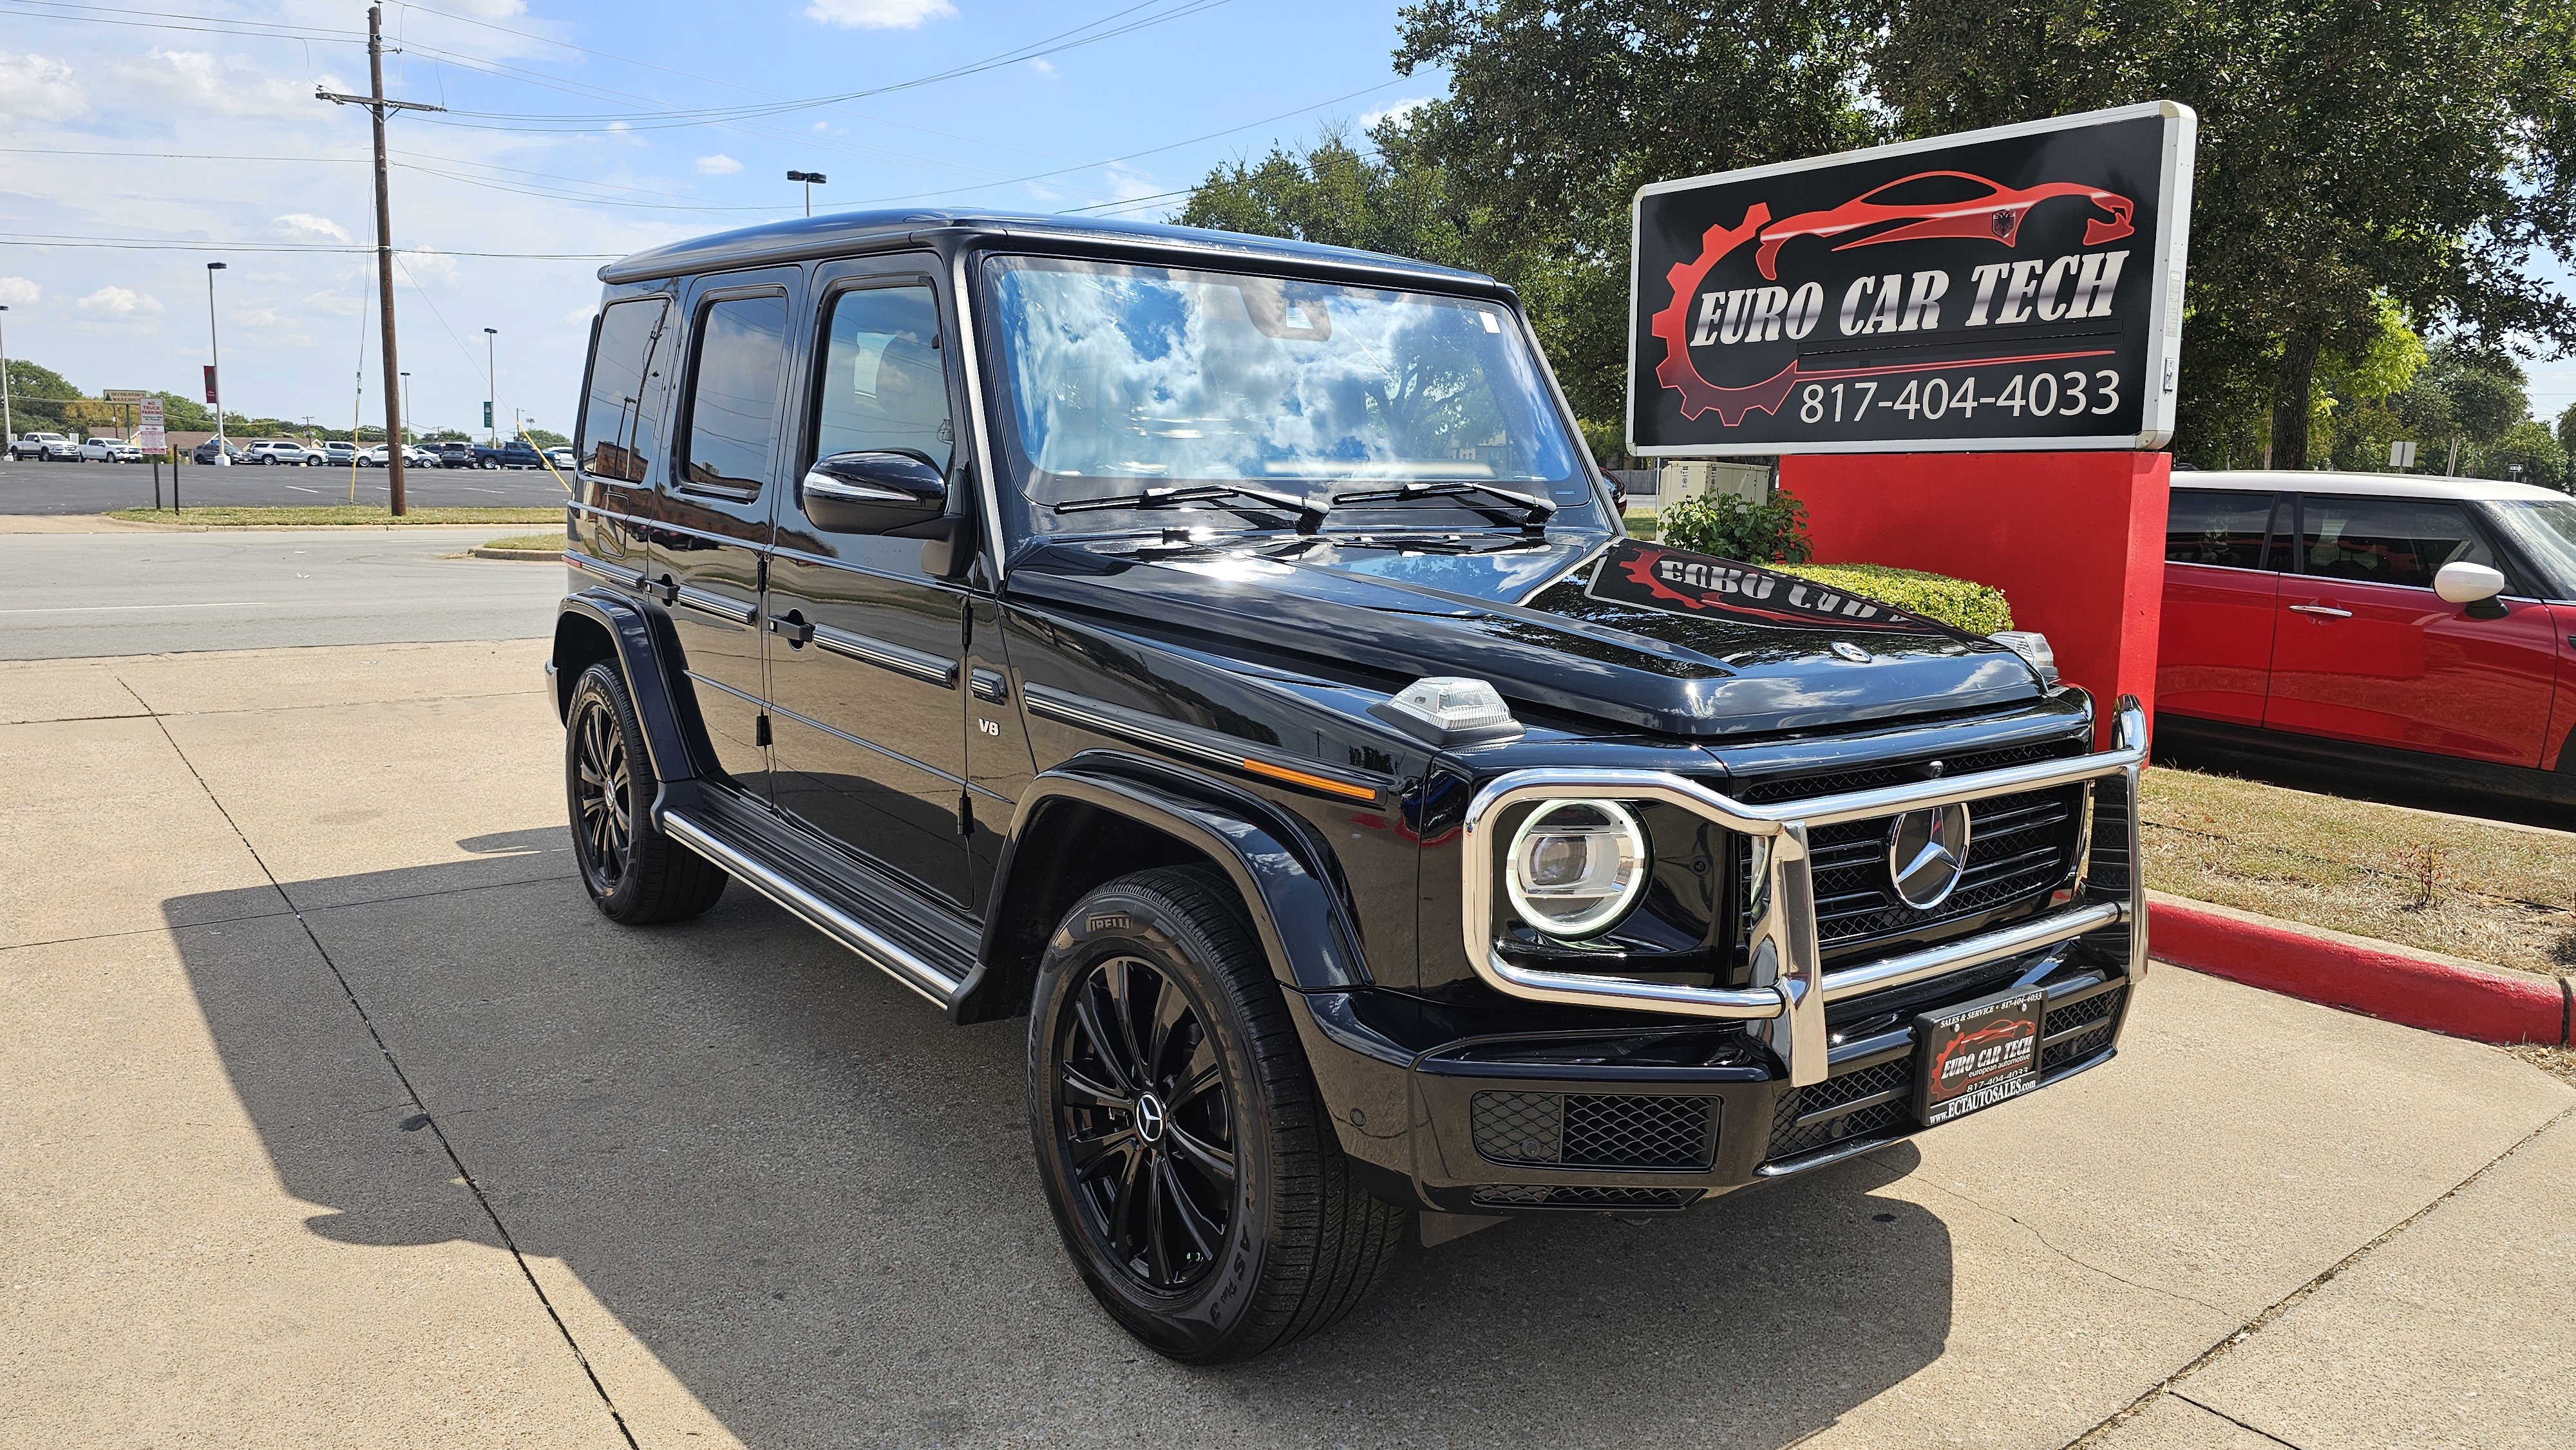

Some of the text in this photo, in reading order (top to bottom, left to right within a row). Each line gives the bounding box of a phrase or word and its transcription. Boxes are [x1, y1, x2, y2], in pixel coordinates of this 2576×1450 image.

[1690, 281, 1824, 347] EURO
[1839, 269, 1951, 336] CAR
[1965, 250, 2130, 327] TECH
[1801, 370, 2120, 424] 817-404-4033
[978, 718, 999, 736] V8
[1086, 909, 1132, 933] PIRELLI
[1940, 992, 2042, 1028] SALES & SERVICE 817-404-4033
[1941, 1035, 2034, 1080] EURO CAR TECH
[1968, 1053, 2031, 1078] european automotive
[1966, 1066, 2029, 1093] 817-404-4033
[1205, 999, 1256, 1214] SCORPION
[1929, 1078, 2036, 1125] www.ECTAUTOSALES.com
